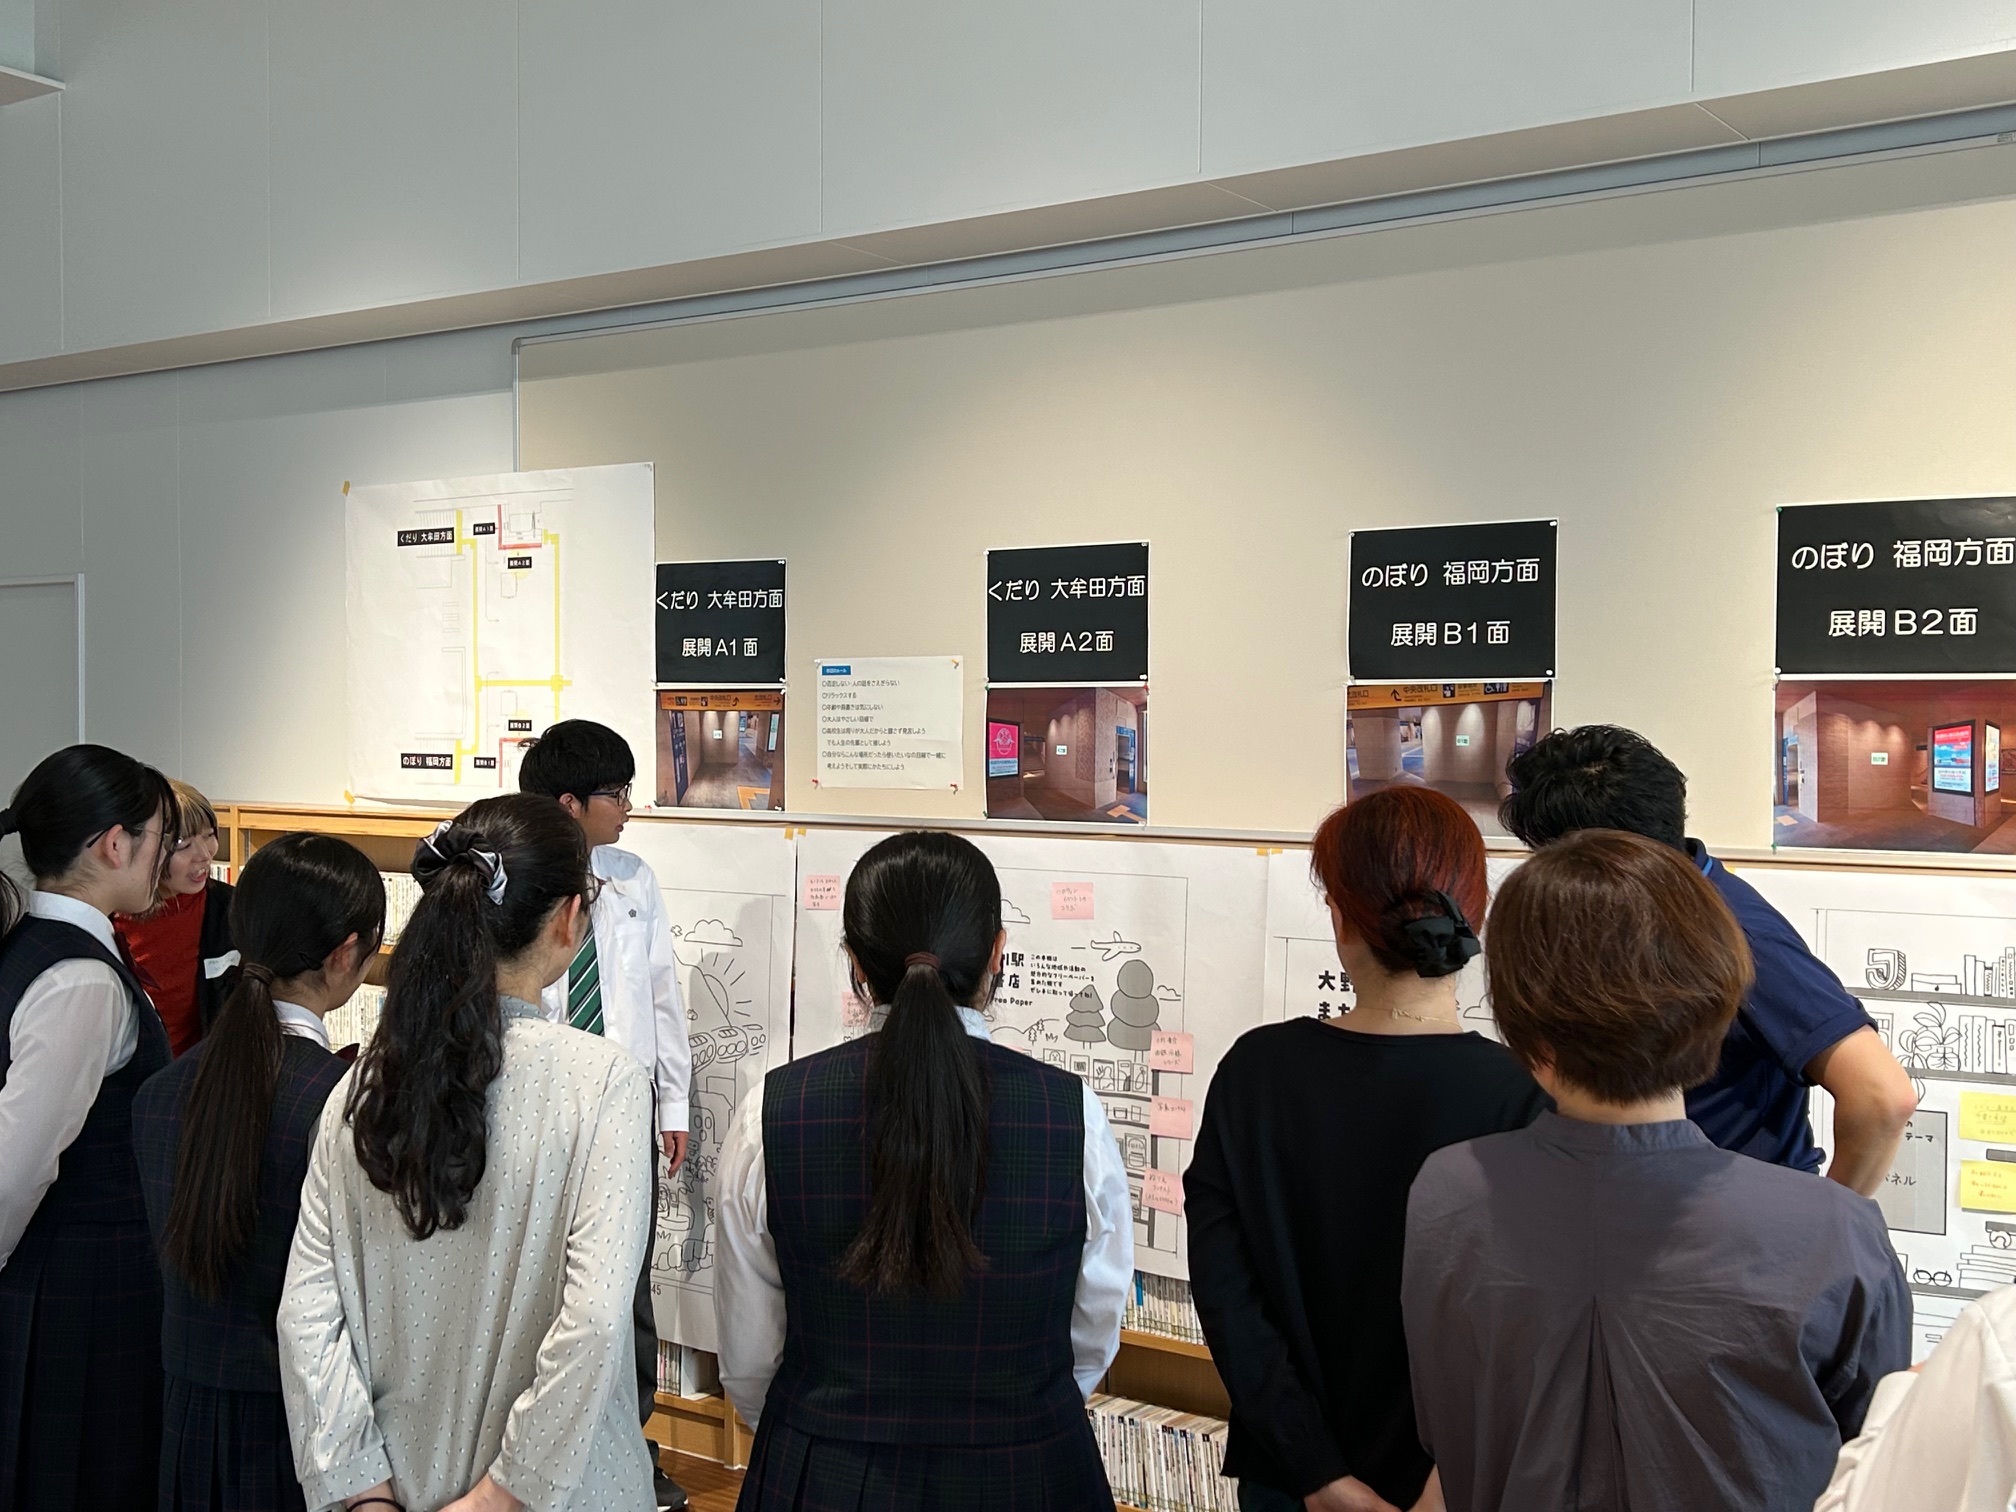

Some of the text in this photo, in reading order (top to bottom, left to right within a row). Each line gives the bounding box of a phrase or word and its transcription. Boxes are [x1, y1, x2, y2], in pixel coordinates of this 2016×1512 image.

[1791, 537, 2016, 570] のぼり 福岡方面
[1361, 558, 1540, 588] のぼり 福岡方面
[656, 588, 784, 610] くだり 大牟田方面
[988, 575, 1146, 601] くだり 大牟田方面
[1010, 997, 1033, 1007] Paper
[1905, 1132, 1934, 1143] テーマ
